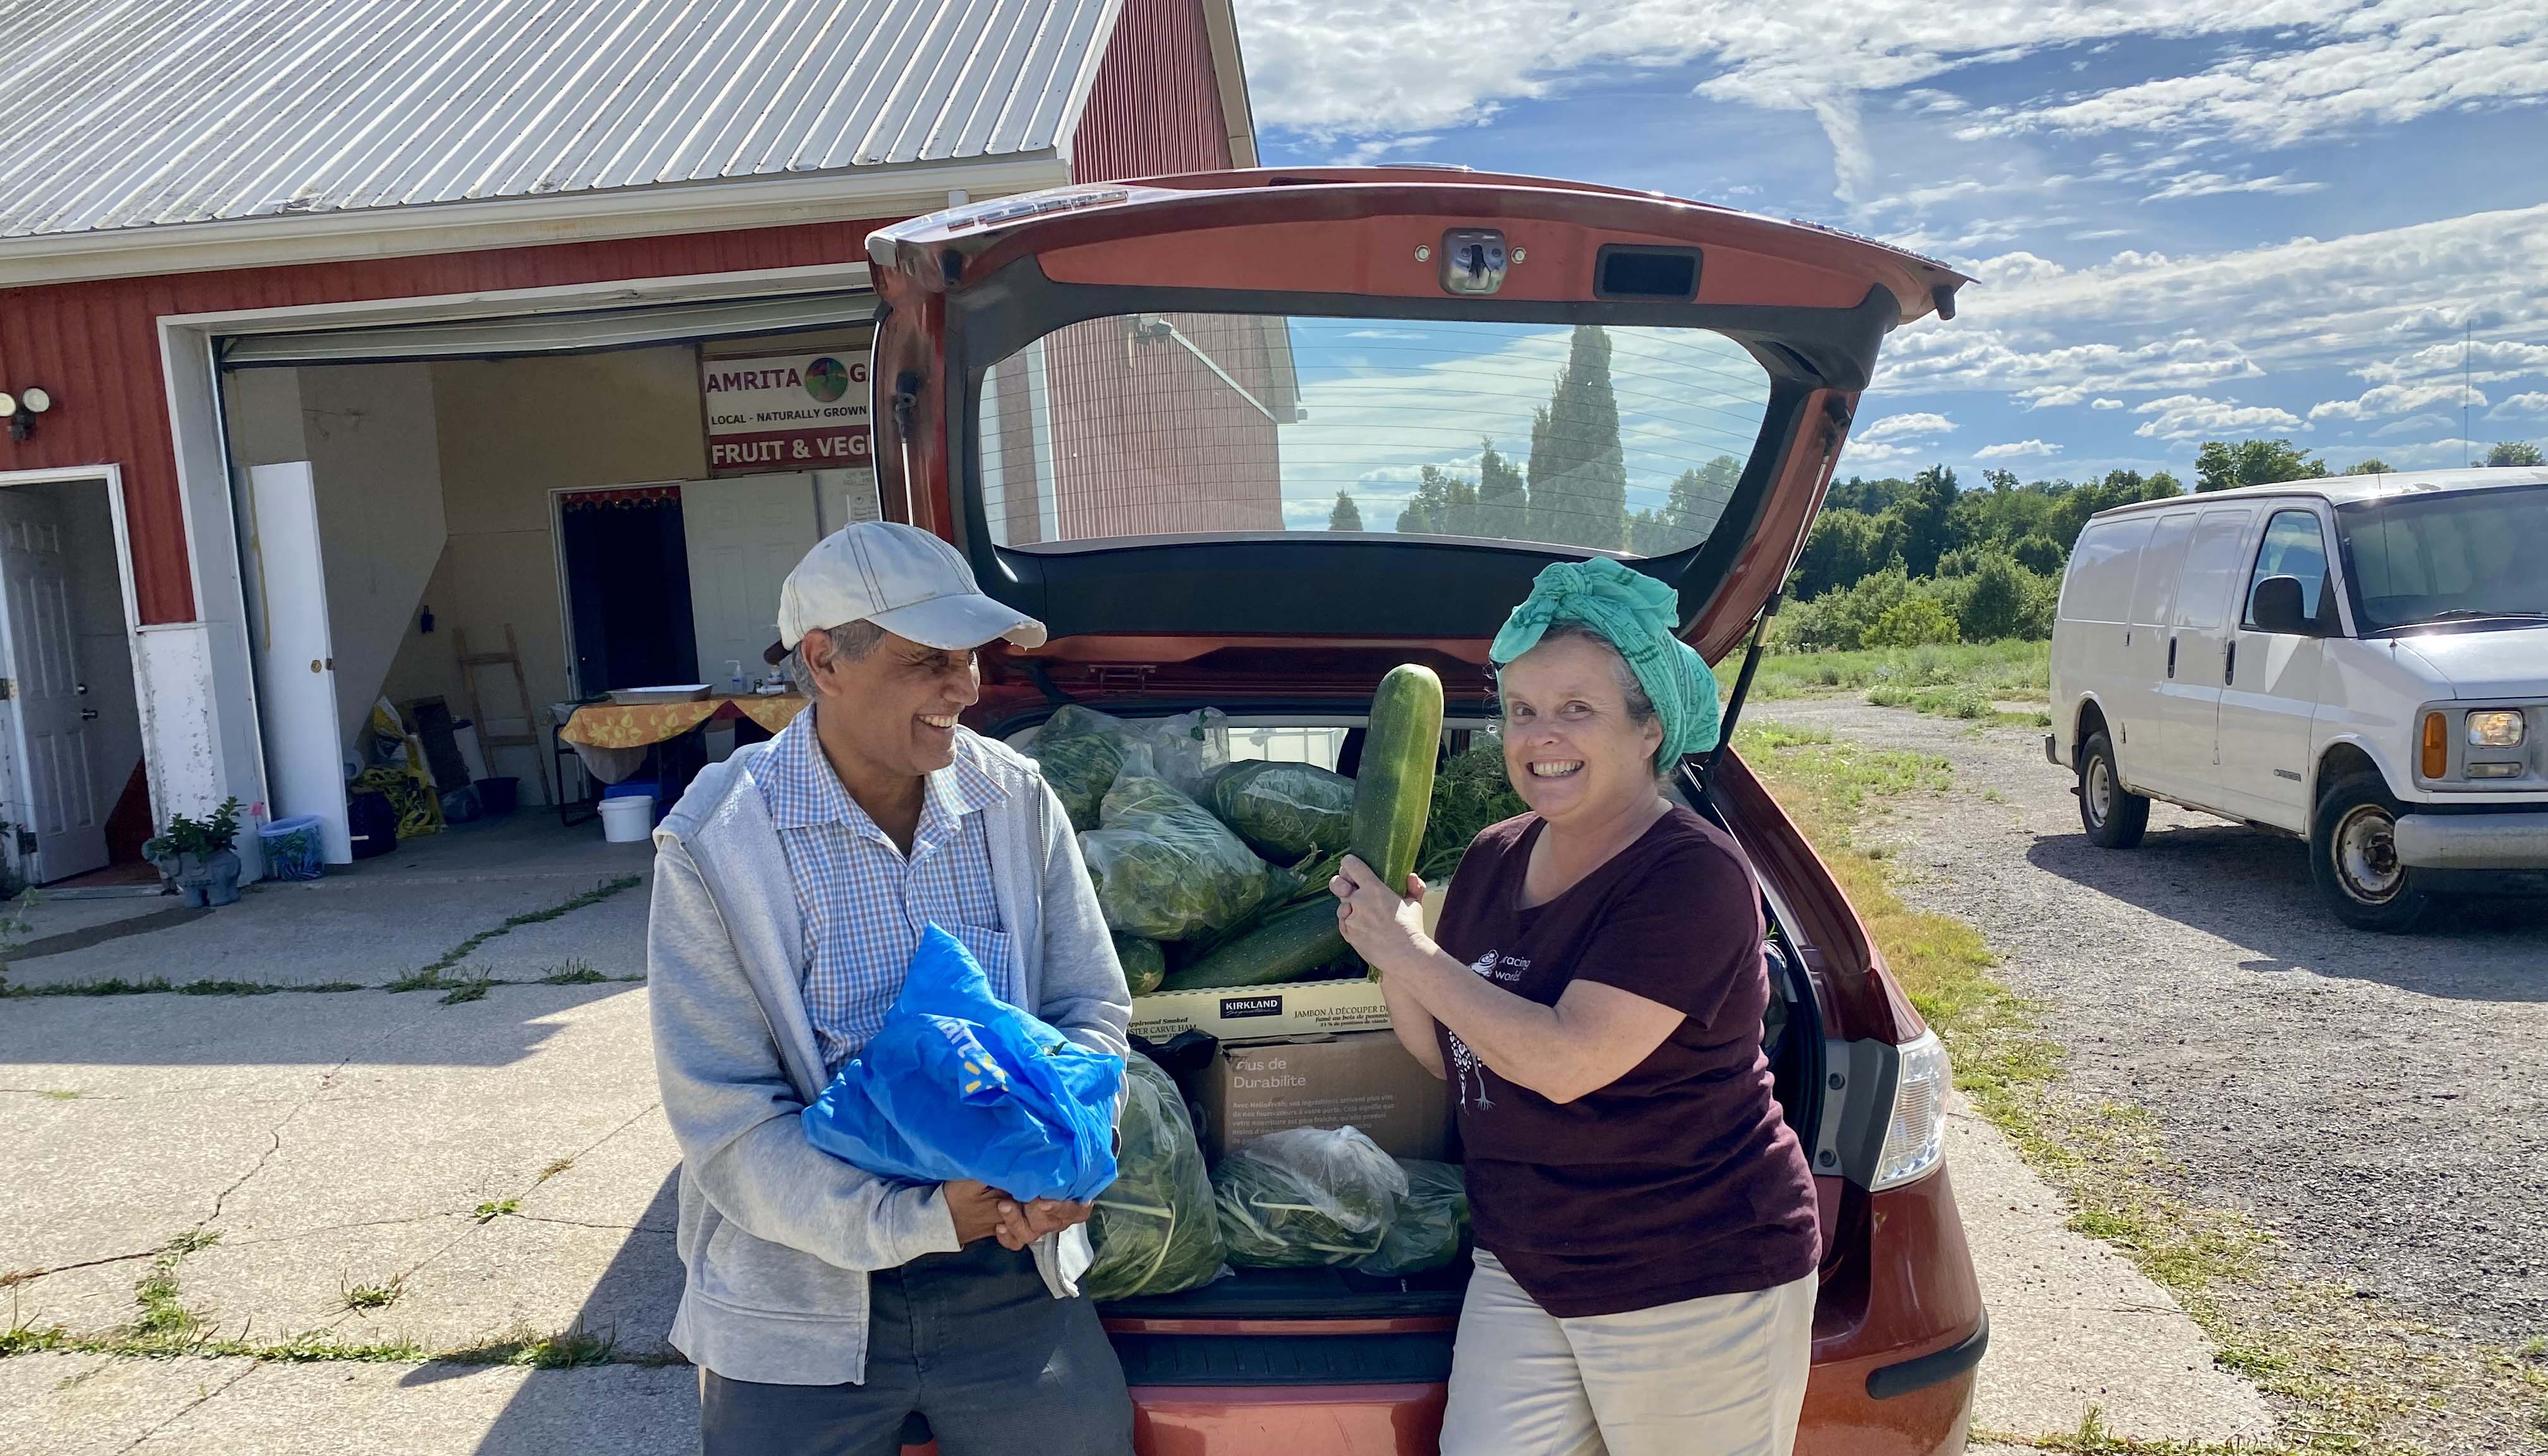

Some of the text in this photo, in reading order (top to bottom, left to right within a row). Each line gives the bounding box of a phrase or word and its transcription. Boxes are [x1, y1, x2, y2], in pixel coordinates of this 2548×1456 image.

[707, 363, 870, 393] AMRITA G
[712, 415, 746, 425] LOCAL
[757, 409, 820, 422] NATURALLY
[824, 405, 867, 417] GROWN
[712, 440, 785, 464] FRUIT
[792, 439, 813, 459] &
[1225, 1000, 1278, 1010] KIRKLAND
[1294, 1009, 1326, 1019] JAMBON
[1335, 1005, 1378, 1016] DÉCOUPER
[1127, 1019, 1162, 1028] Applewood
[1150, 1025, 1176, 1034] CARVE
[1268, 1057, 1287, 1070] de
